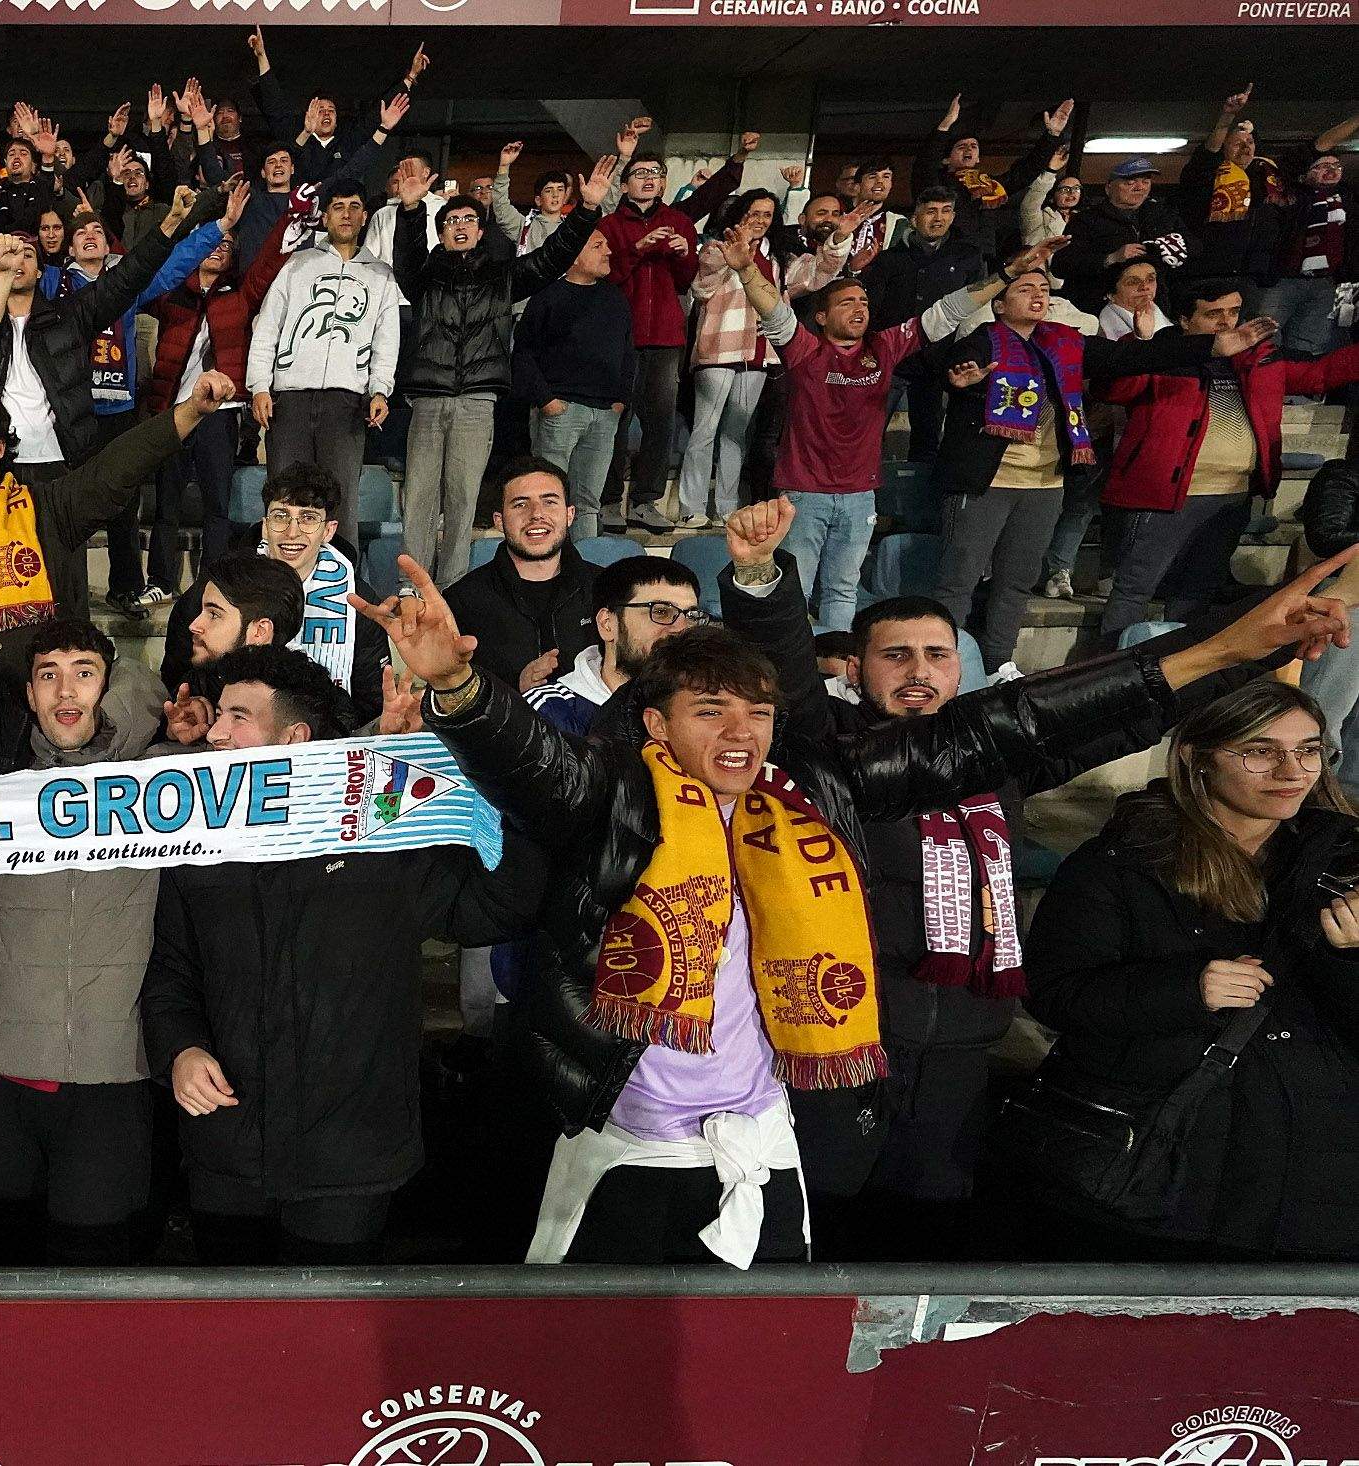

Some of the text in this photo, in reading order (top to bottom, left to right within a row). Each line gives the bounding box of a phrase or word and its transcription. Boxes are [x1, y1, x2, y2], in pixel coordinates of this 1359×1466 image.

[907, 0, 980, 15] COCINA
[1237, 2, 1351, 18] PONTEVEDRA
[302, 550, 350, 645] OVE
[37, 757, 292, 839] GROVE
[340, 749, 366, 842] C.D. GROVE
[6, 852, 45, 870] que
[53, 849, 80, 862] un
[361, 1384, 542, 1430] CONSERVAS
[1170, 1405, 1301, 1440] CONSERVAS
